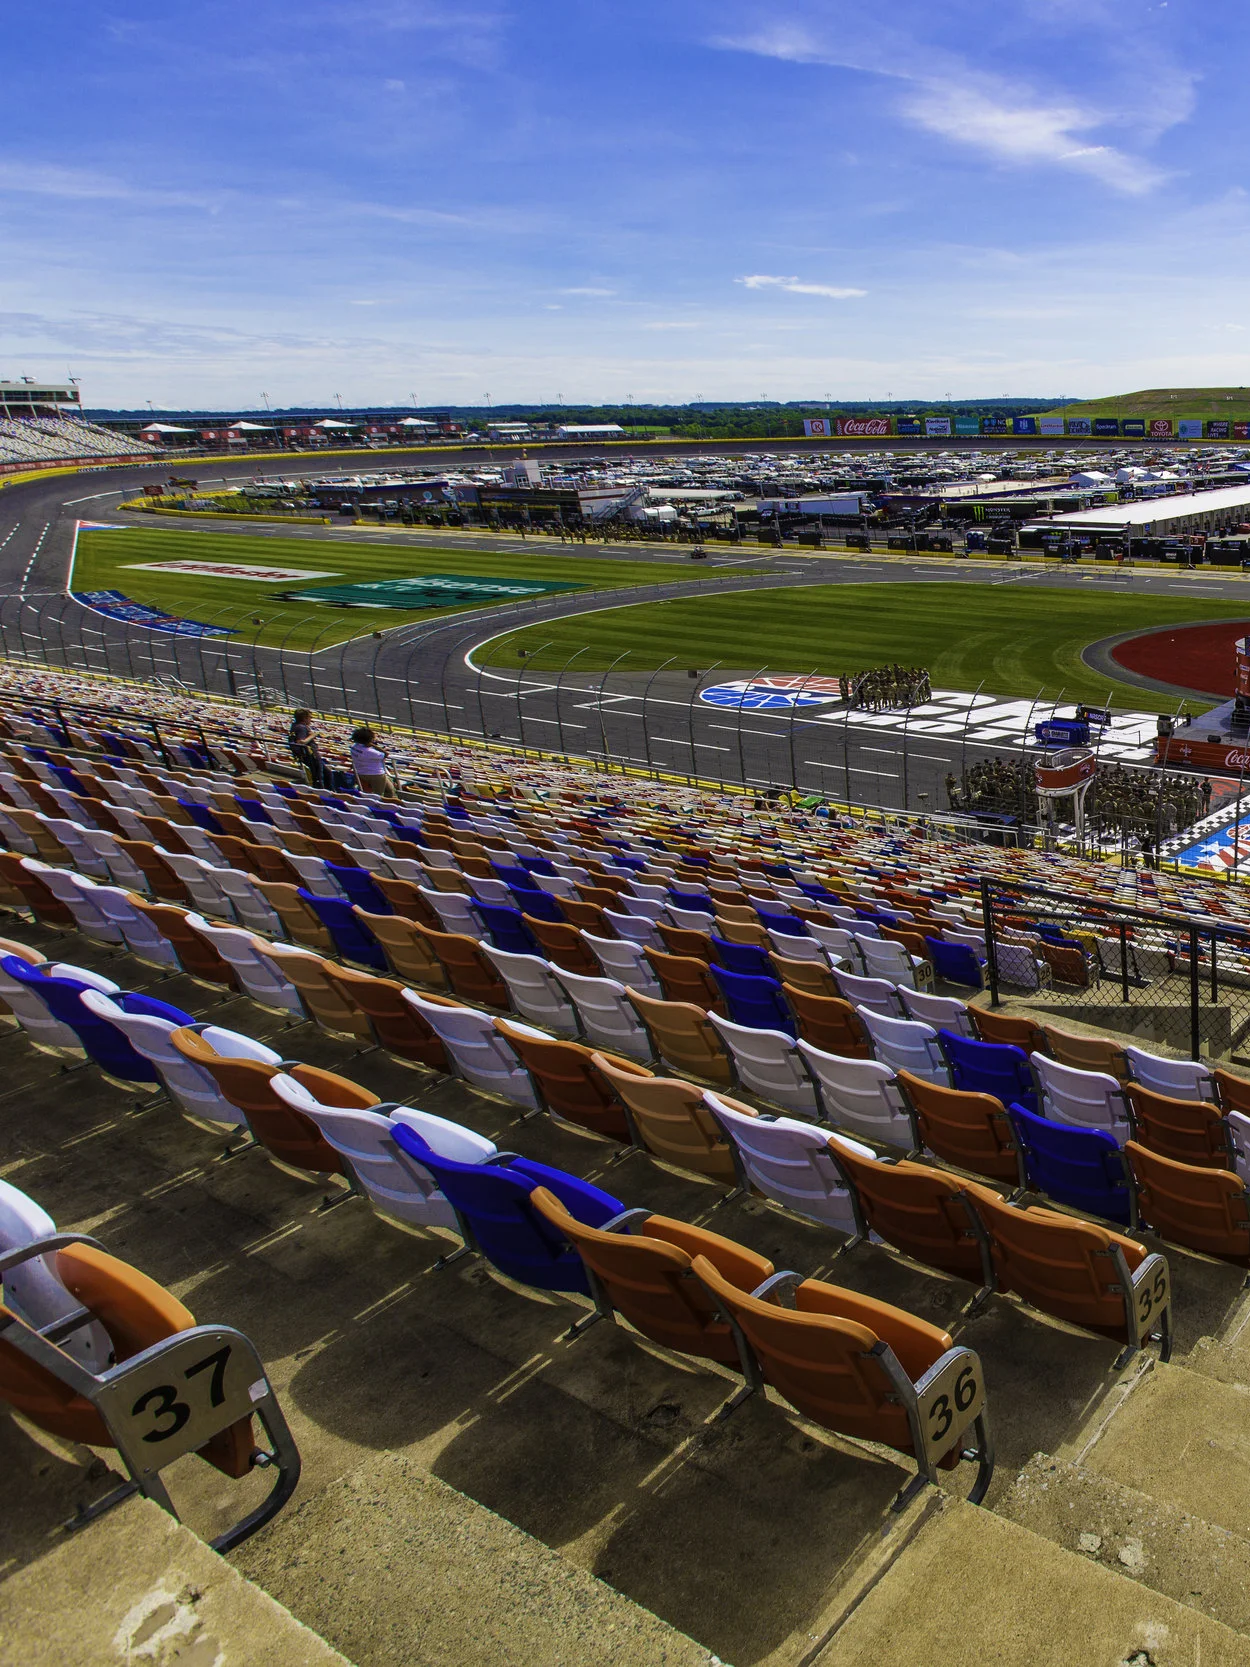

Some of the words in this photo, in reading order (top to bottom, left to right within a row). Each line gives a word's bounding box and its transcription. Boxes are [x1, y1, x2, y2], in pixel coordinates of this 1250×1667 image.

[844, 419, 888, 435] Coca-Cola
[381, 577, 547, 594] Hisense
[1139, 1267, 1166, 1323] 35
[132, 1344, 232, 1443] 37
[929, 1366, 977, 1442] 36
